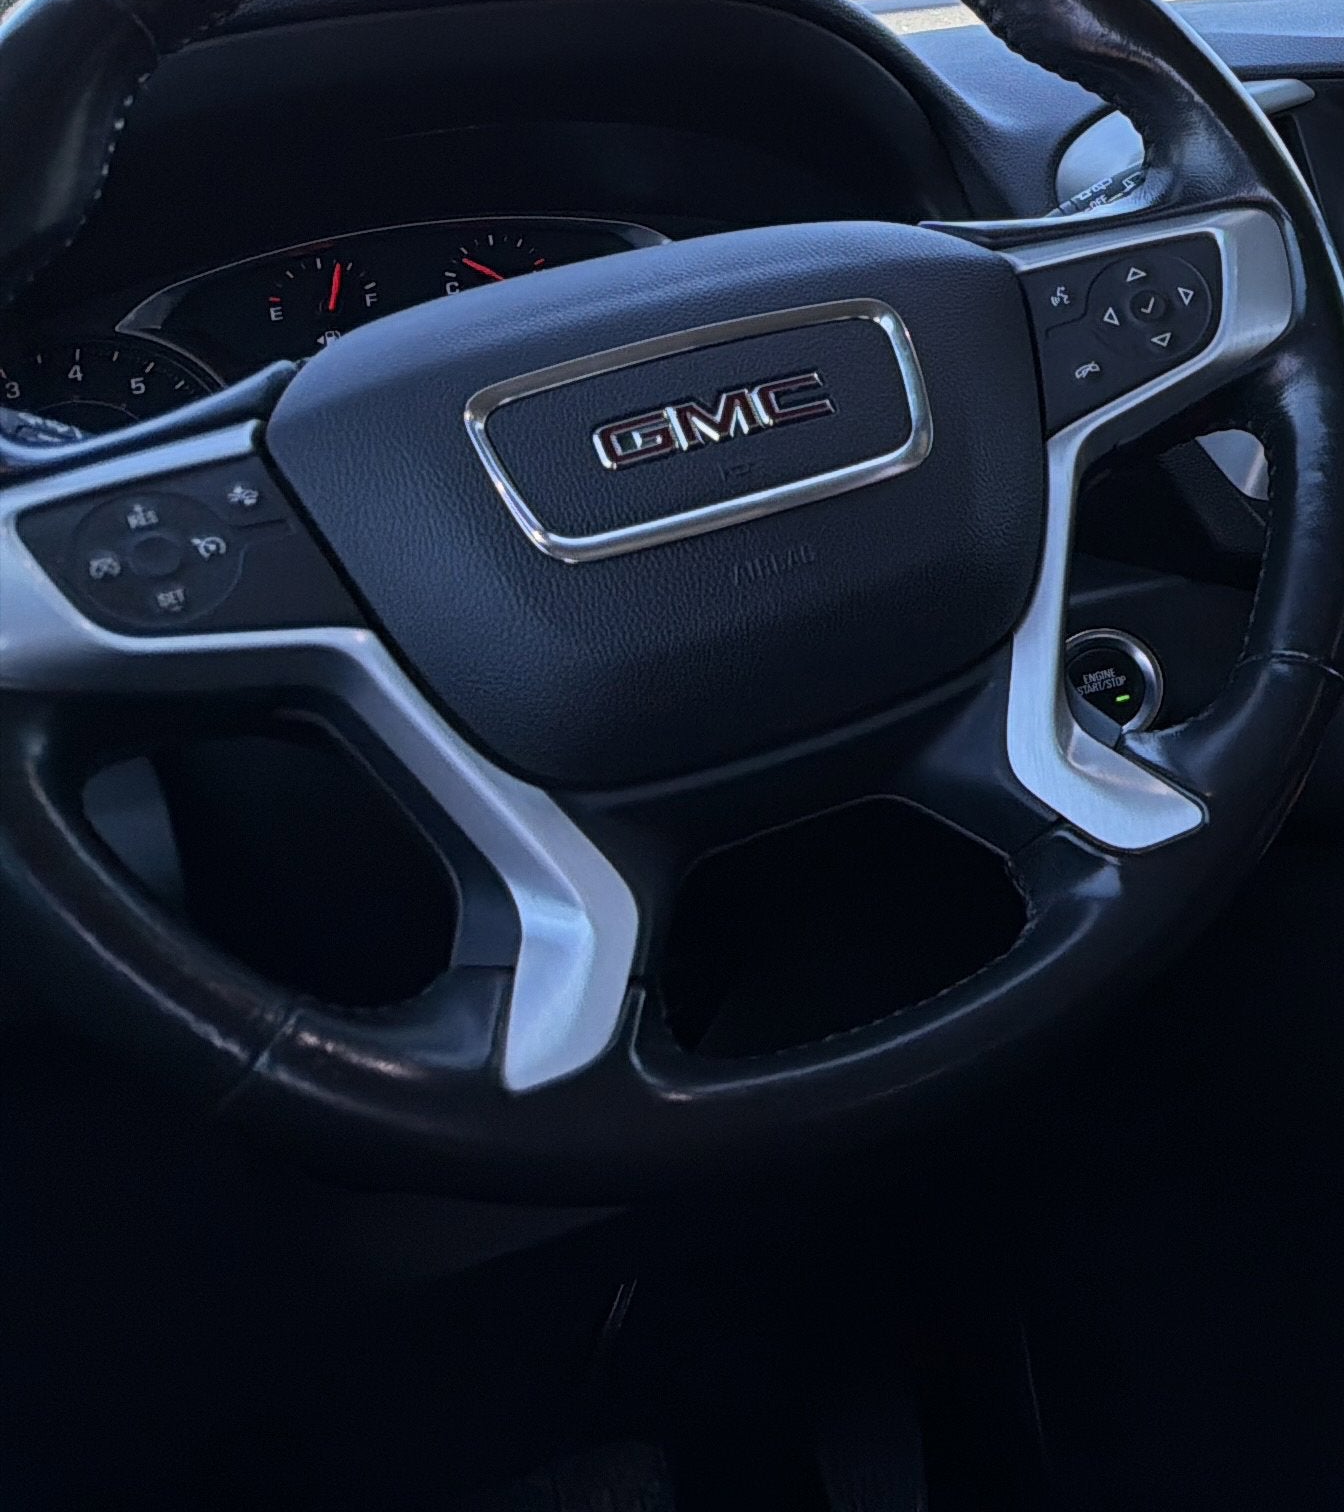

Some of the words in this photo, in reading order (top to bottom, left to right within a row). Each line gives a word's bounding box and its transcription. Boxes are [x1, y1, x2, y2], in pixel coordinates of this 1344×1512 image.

[365, 293, 377, 307] F
[270, 306, 283, 321] E
[6, 381, 21, 399] 3
[67, 364, 84, 381] 4
[130, 377, 146, 395] 5
[592, 372, 837, 471] GMC
[1082, 668, 1116, 684] ENGINE
[1077, 675, 1127, 696] START/STOP
